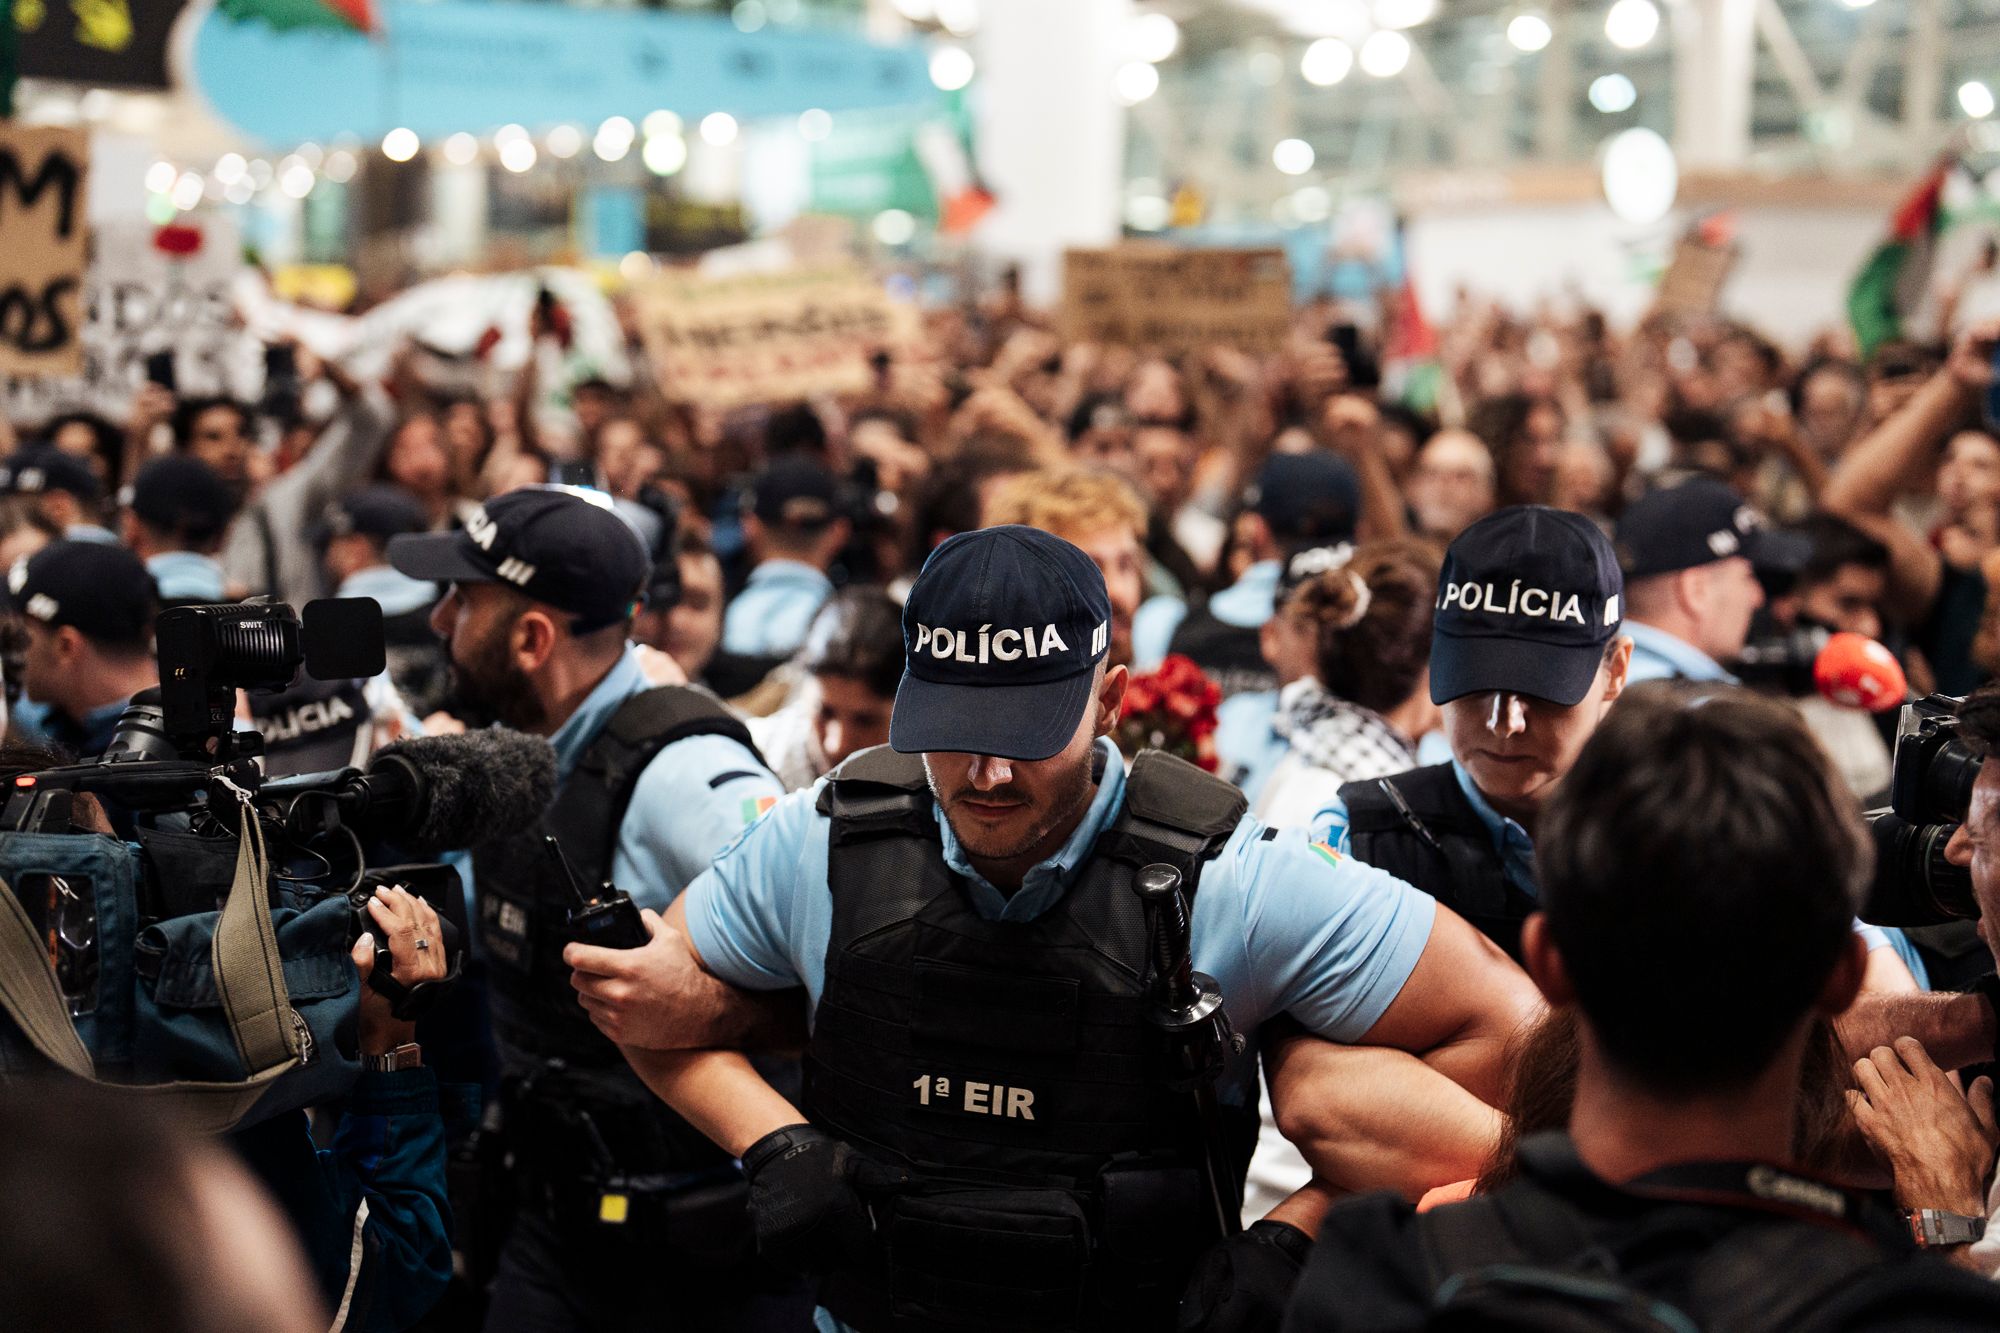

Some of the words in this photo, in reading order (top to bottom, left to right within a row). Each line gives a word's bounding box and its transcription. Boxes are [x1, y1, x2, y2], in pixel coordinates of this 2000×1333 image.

[1441, 579, 1586, 625] POLÍCIA
[240, 621, 262, 629] SWIT
[914, 622, 1069, 664] POLÍCIA
[913, 1074, 950, 1105] 1ª
[964, 1081, 1034, 1120] EIR
